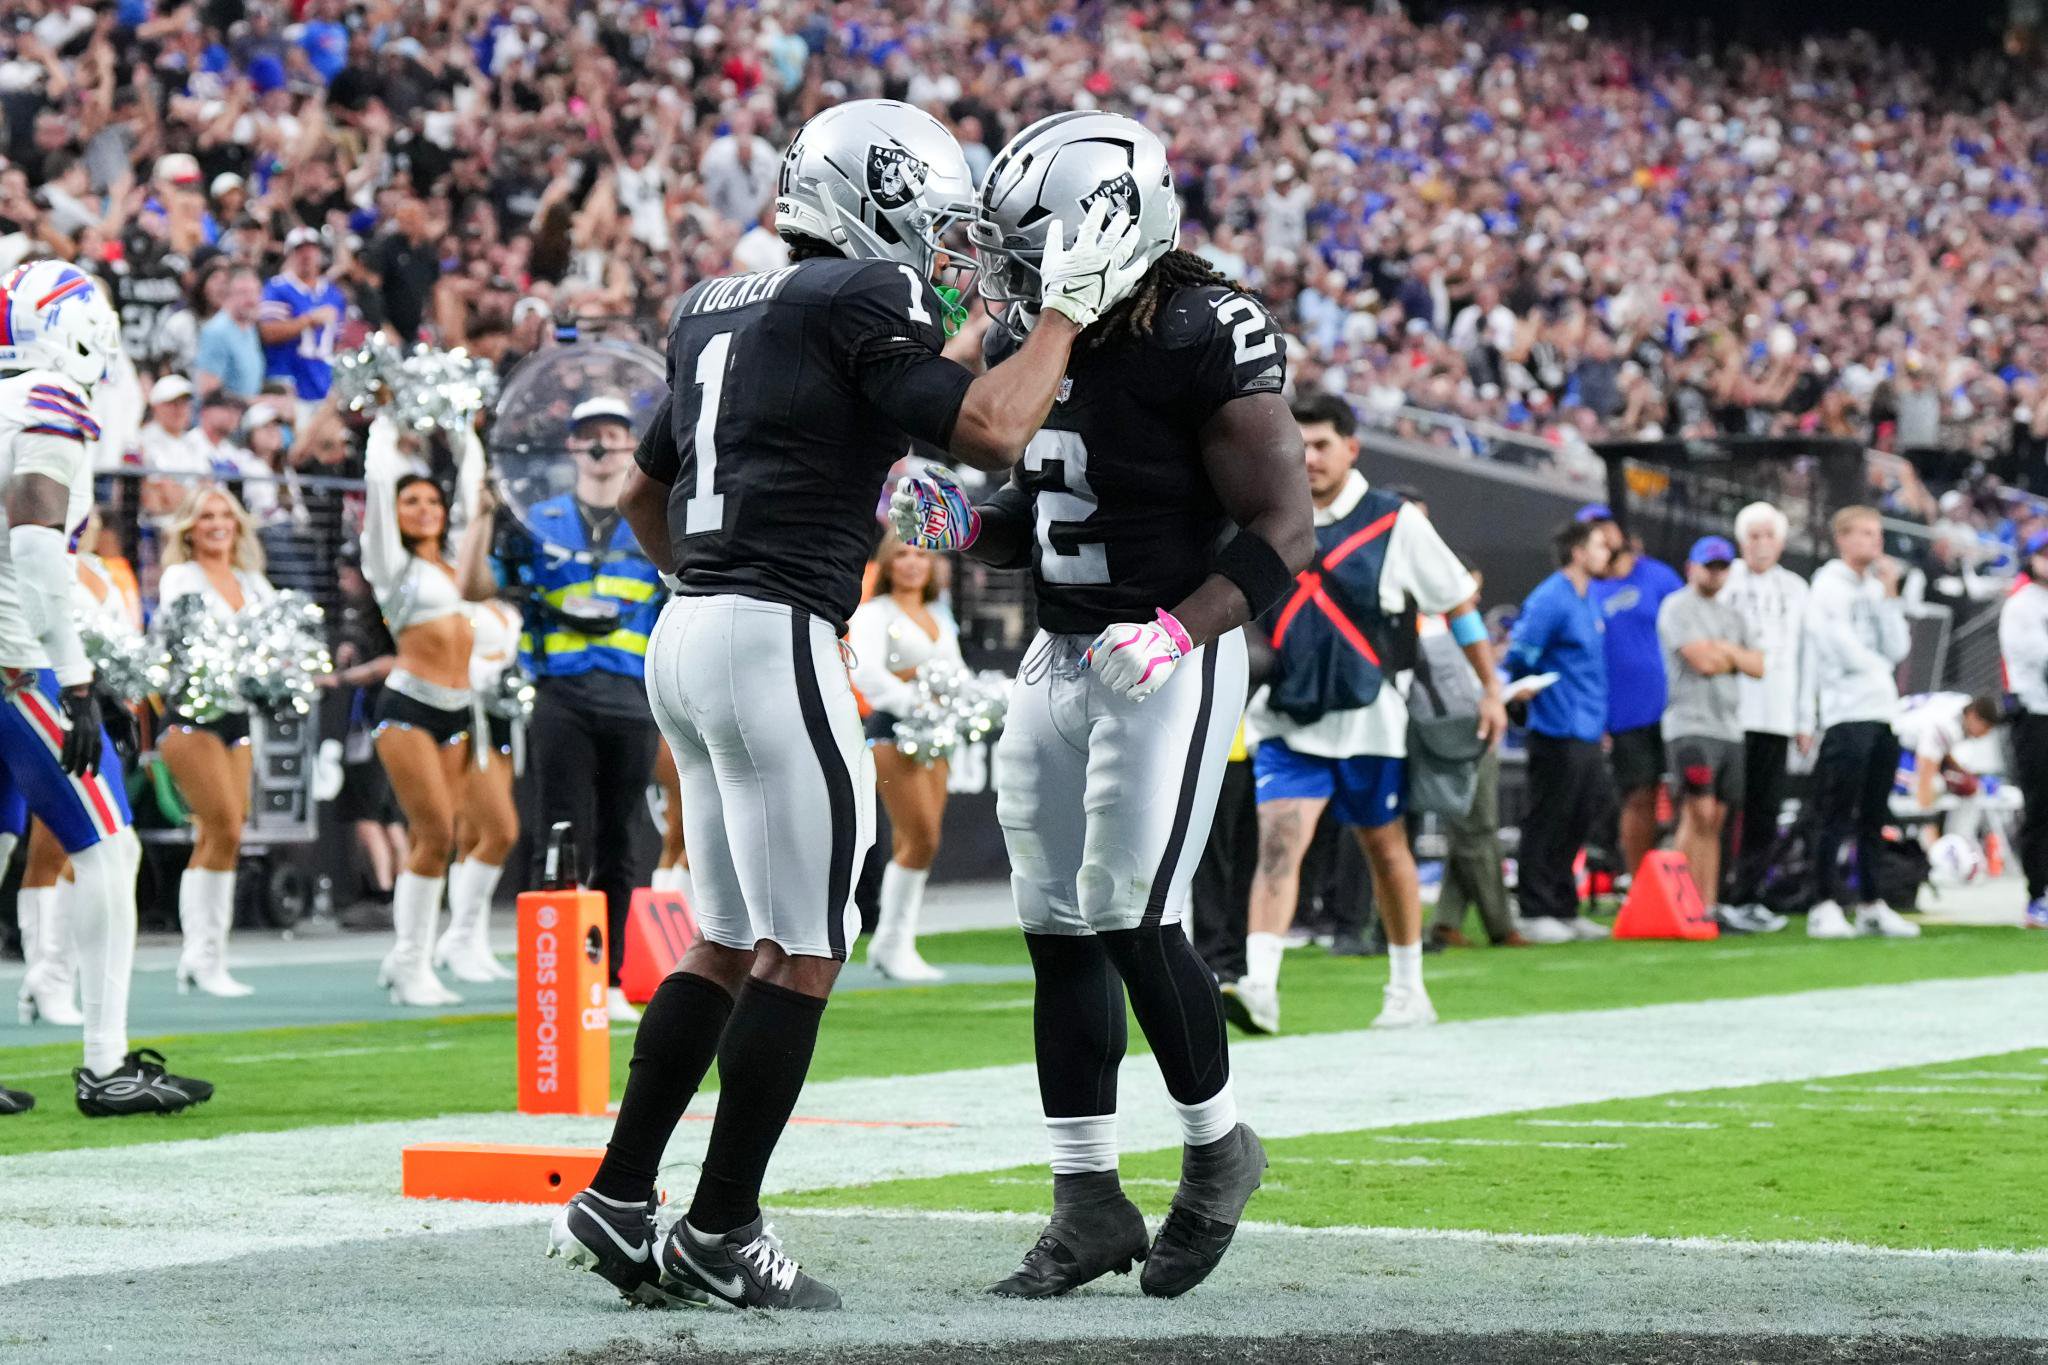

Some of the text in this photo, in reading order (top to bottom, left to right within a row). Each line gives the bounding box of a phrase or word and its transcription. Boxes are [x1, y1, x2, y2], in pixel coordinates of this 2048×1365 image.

[691, 264, 800, 314] TUCKER
[898, 264, 933, 326] 1
[1216, 297, 1277, 365] 2
[685, 331, 733, 535] 1
[924, 510, 947, 537] NFL
[1023, 428, 1112, 584] 2
[536, 932, 558, 1094] CBS SPORTS
